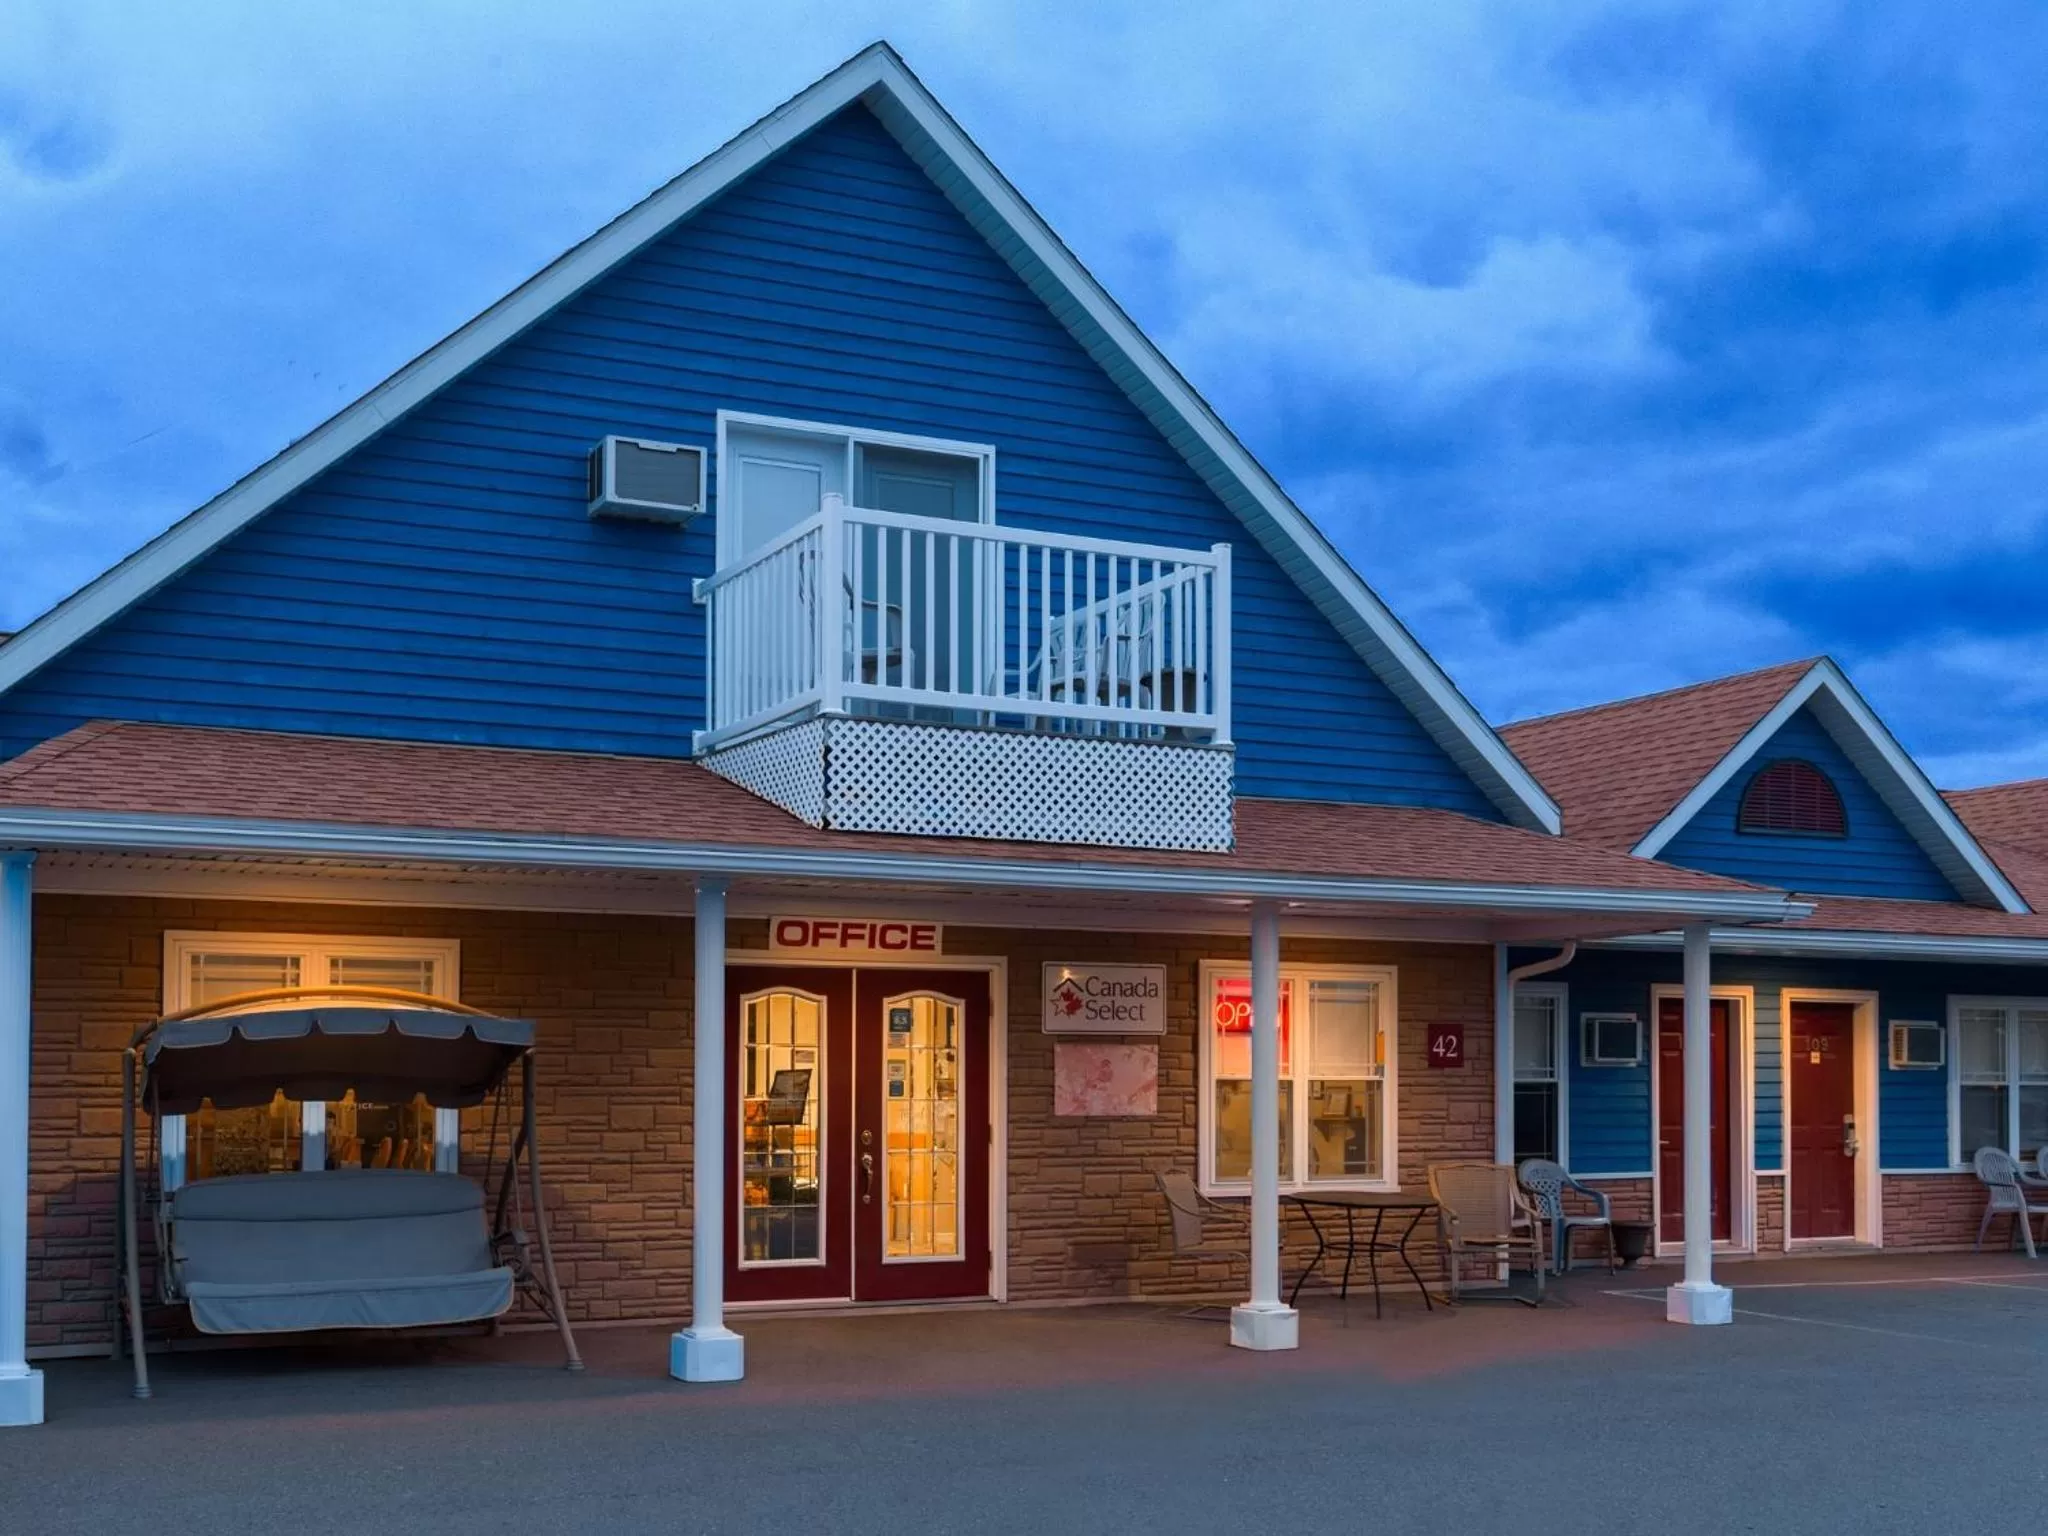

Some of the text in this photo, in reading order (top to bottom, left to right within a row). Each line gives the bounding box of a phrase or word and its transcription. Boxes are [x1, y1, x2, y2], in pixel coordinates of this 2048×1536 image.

[776, 920, 936, 950] OFFICE
[1085, 976, 1158, 998] Canada
[1085, 1000, 1145, 1021] Select
[1432, 1035, 1458, 1057] 42
